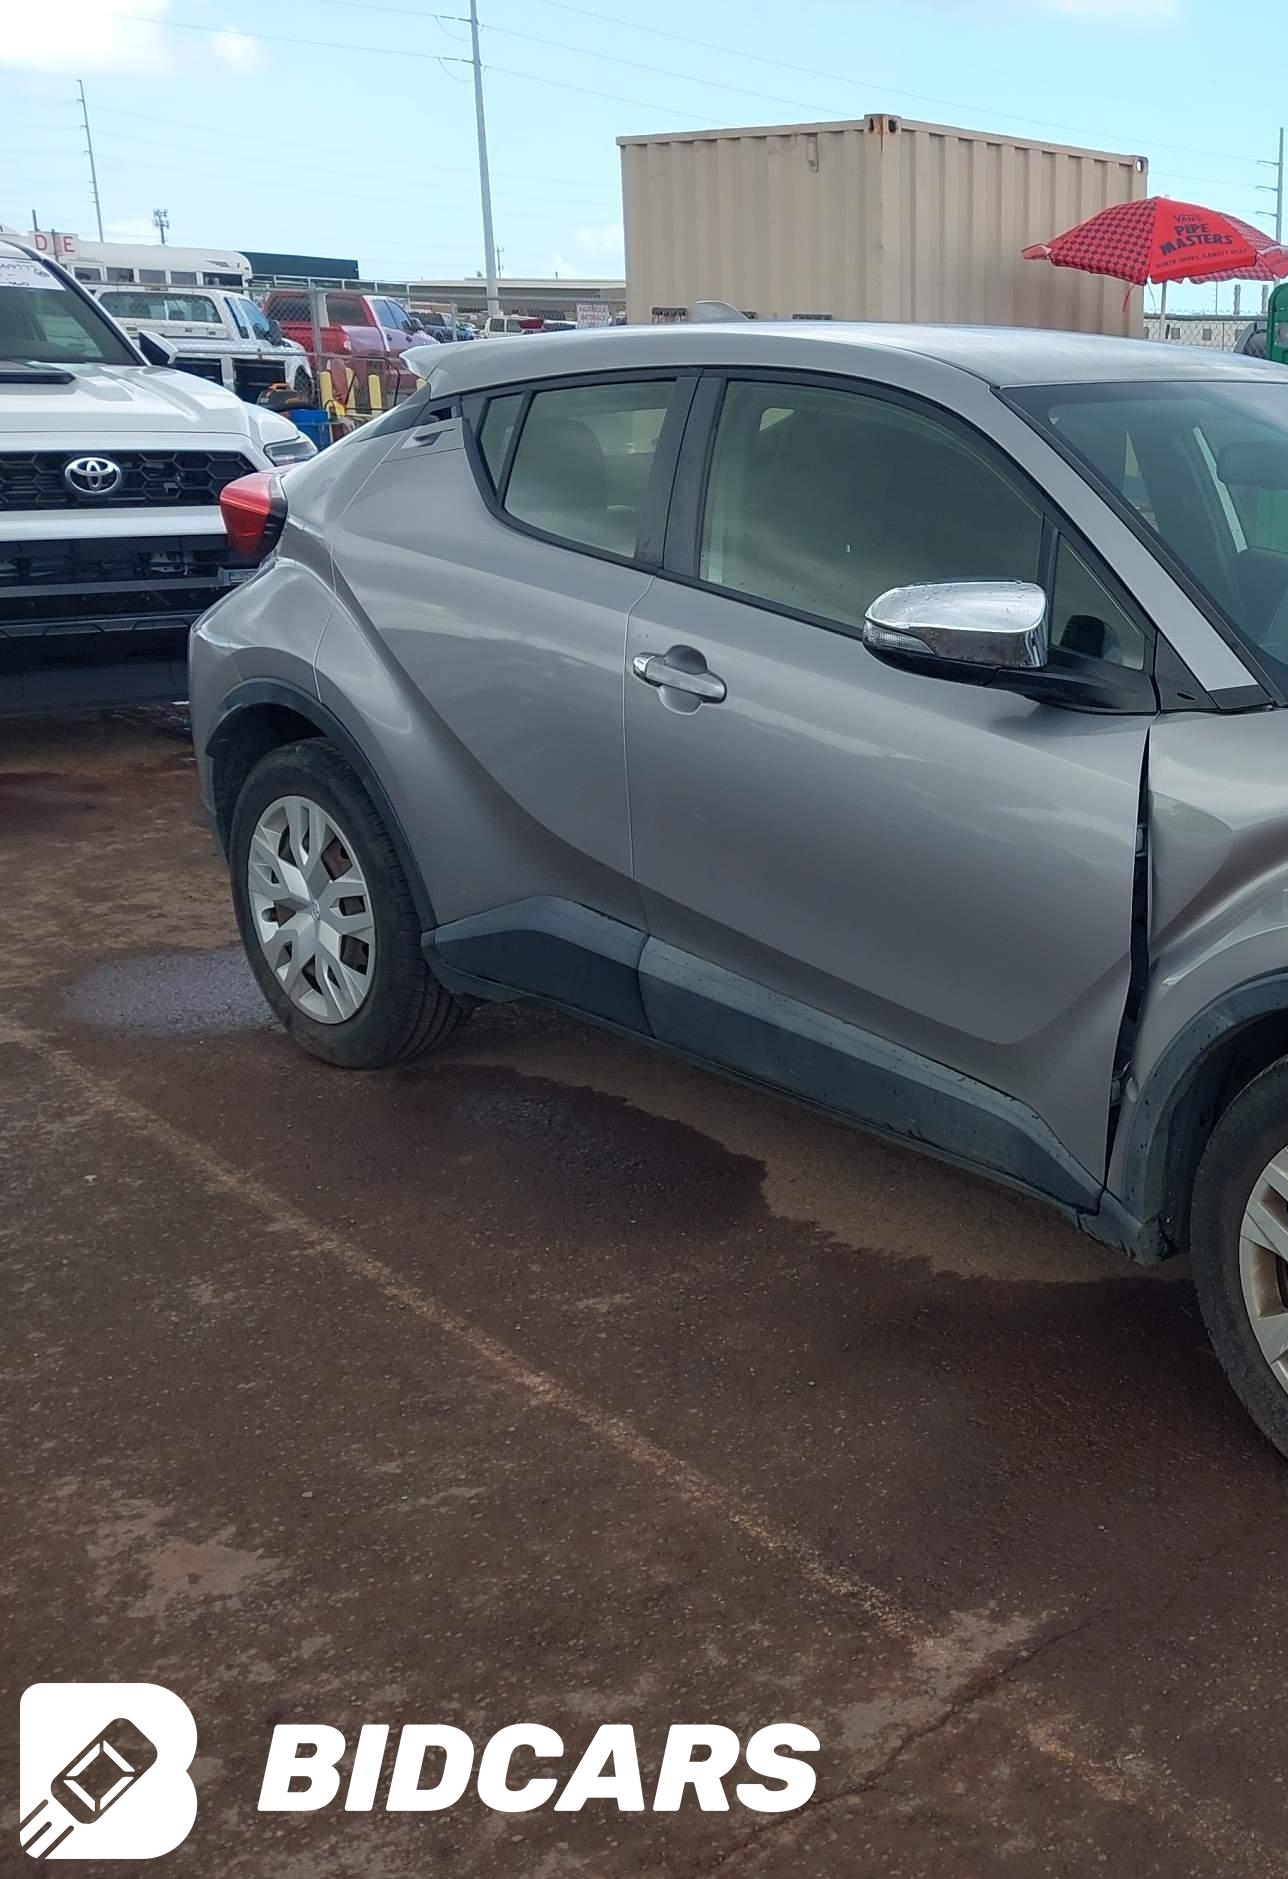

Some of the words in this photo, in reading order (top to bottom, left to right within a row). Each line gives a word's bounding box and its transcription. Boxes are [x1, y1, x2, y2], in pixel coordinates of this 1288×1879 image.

[1174, 223, 1209, 236] PIPE
[34, 234, 48, 251] D
[63, 236, 75, 252] E
[1160, 234, 1233, 256] MASTERS
